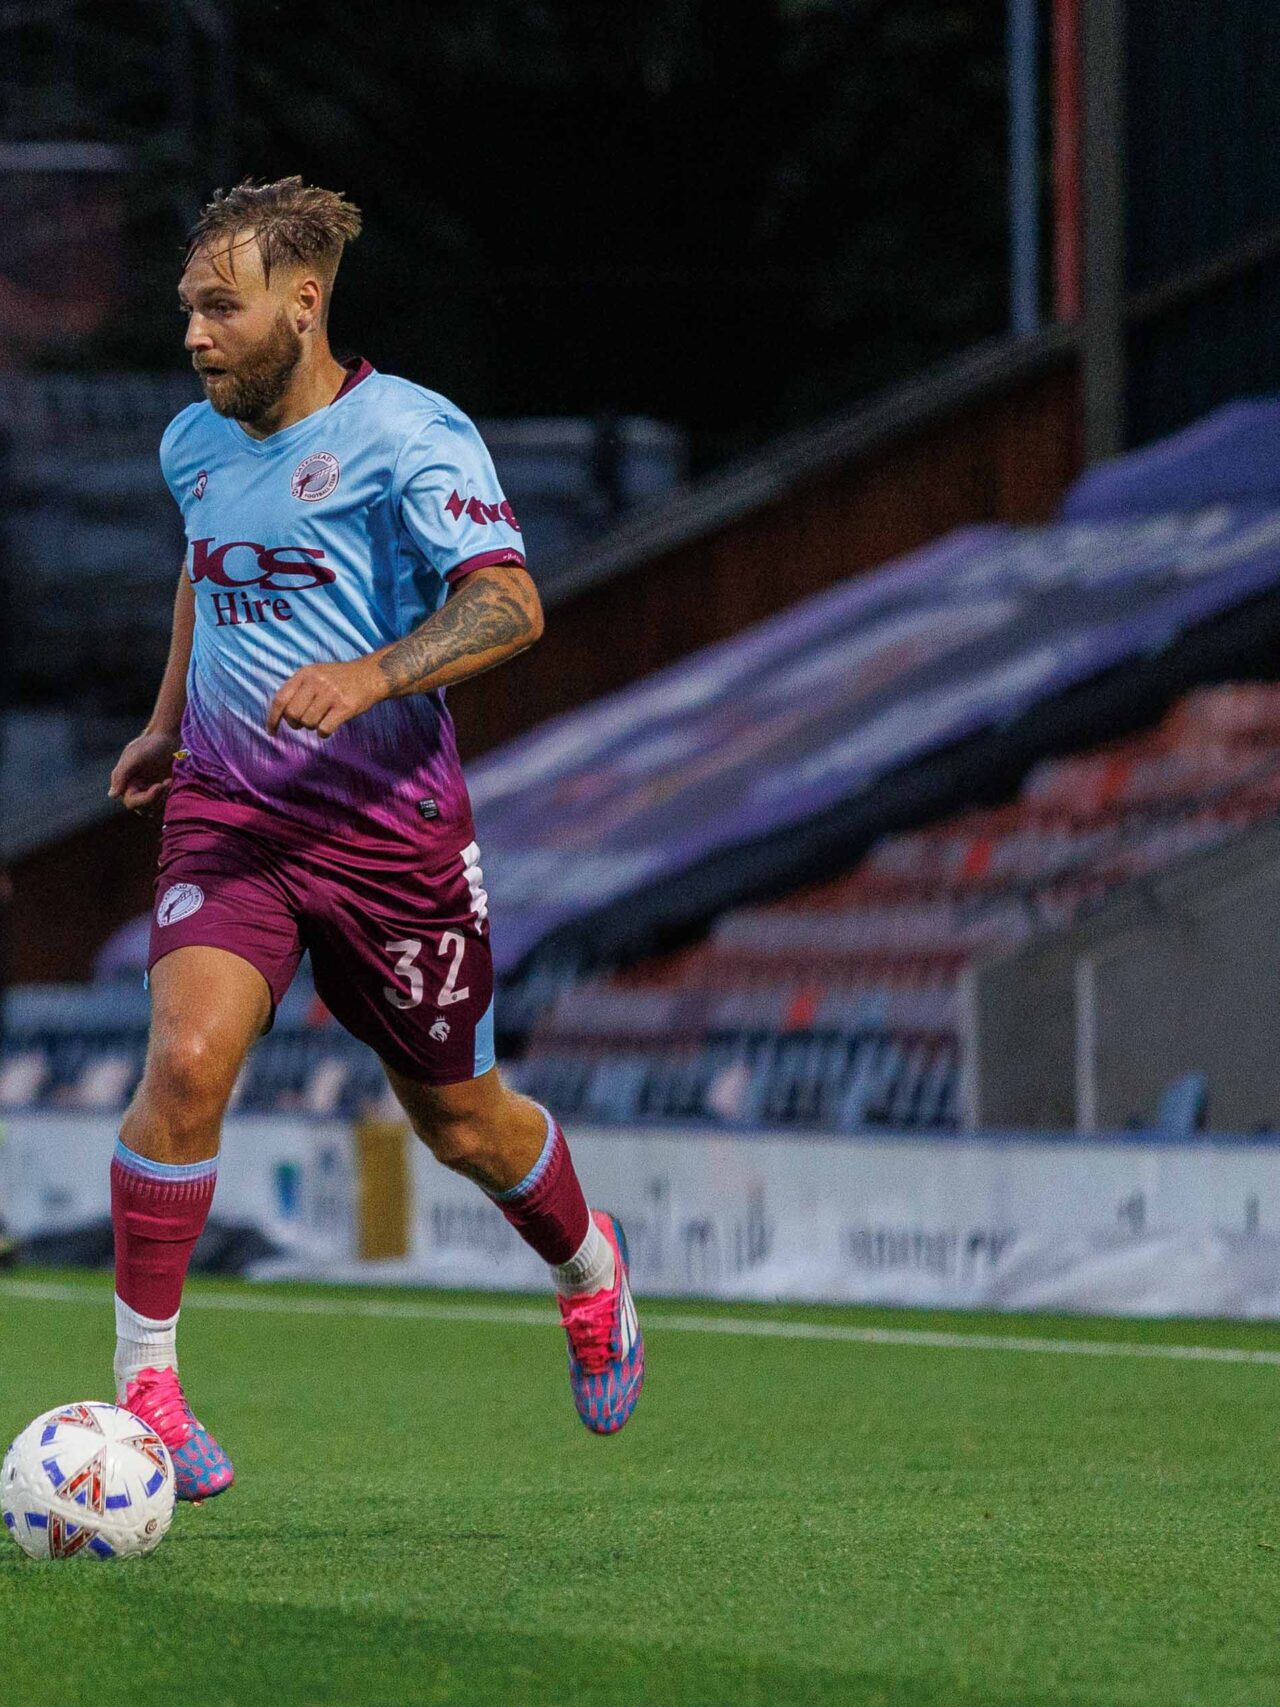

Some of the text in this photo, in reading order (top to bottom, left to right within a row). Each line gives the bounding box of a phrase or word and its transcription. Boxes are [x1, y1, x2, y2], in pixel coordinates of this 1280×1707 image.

[190, 537, 337, 591] JCS
[211, 591, 293, 626] Hire
[383, 928, 469, 1010] 32
